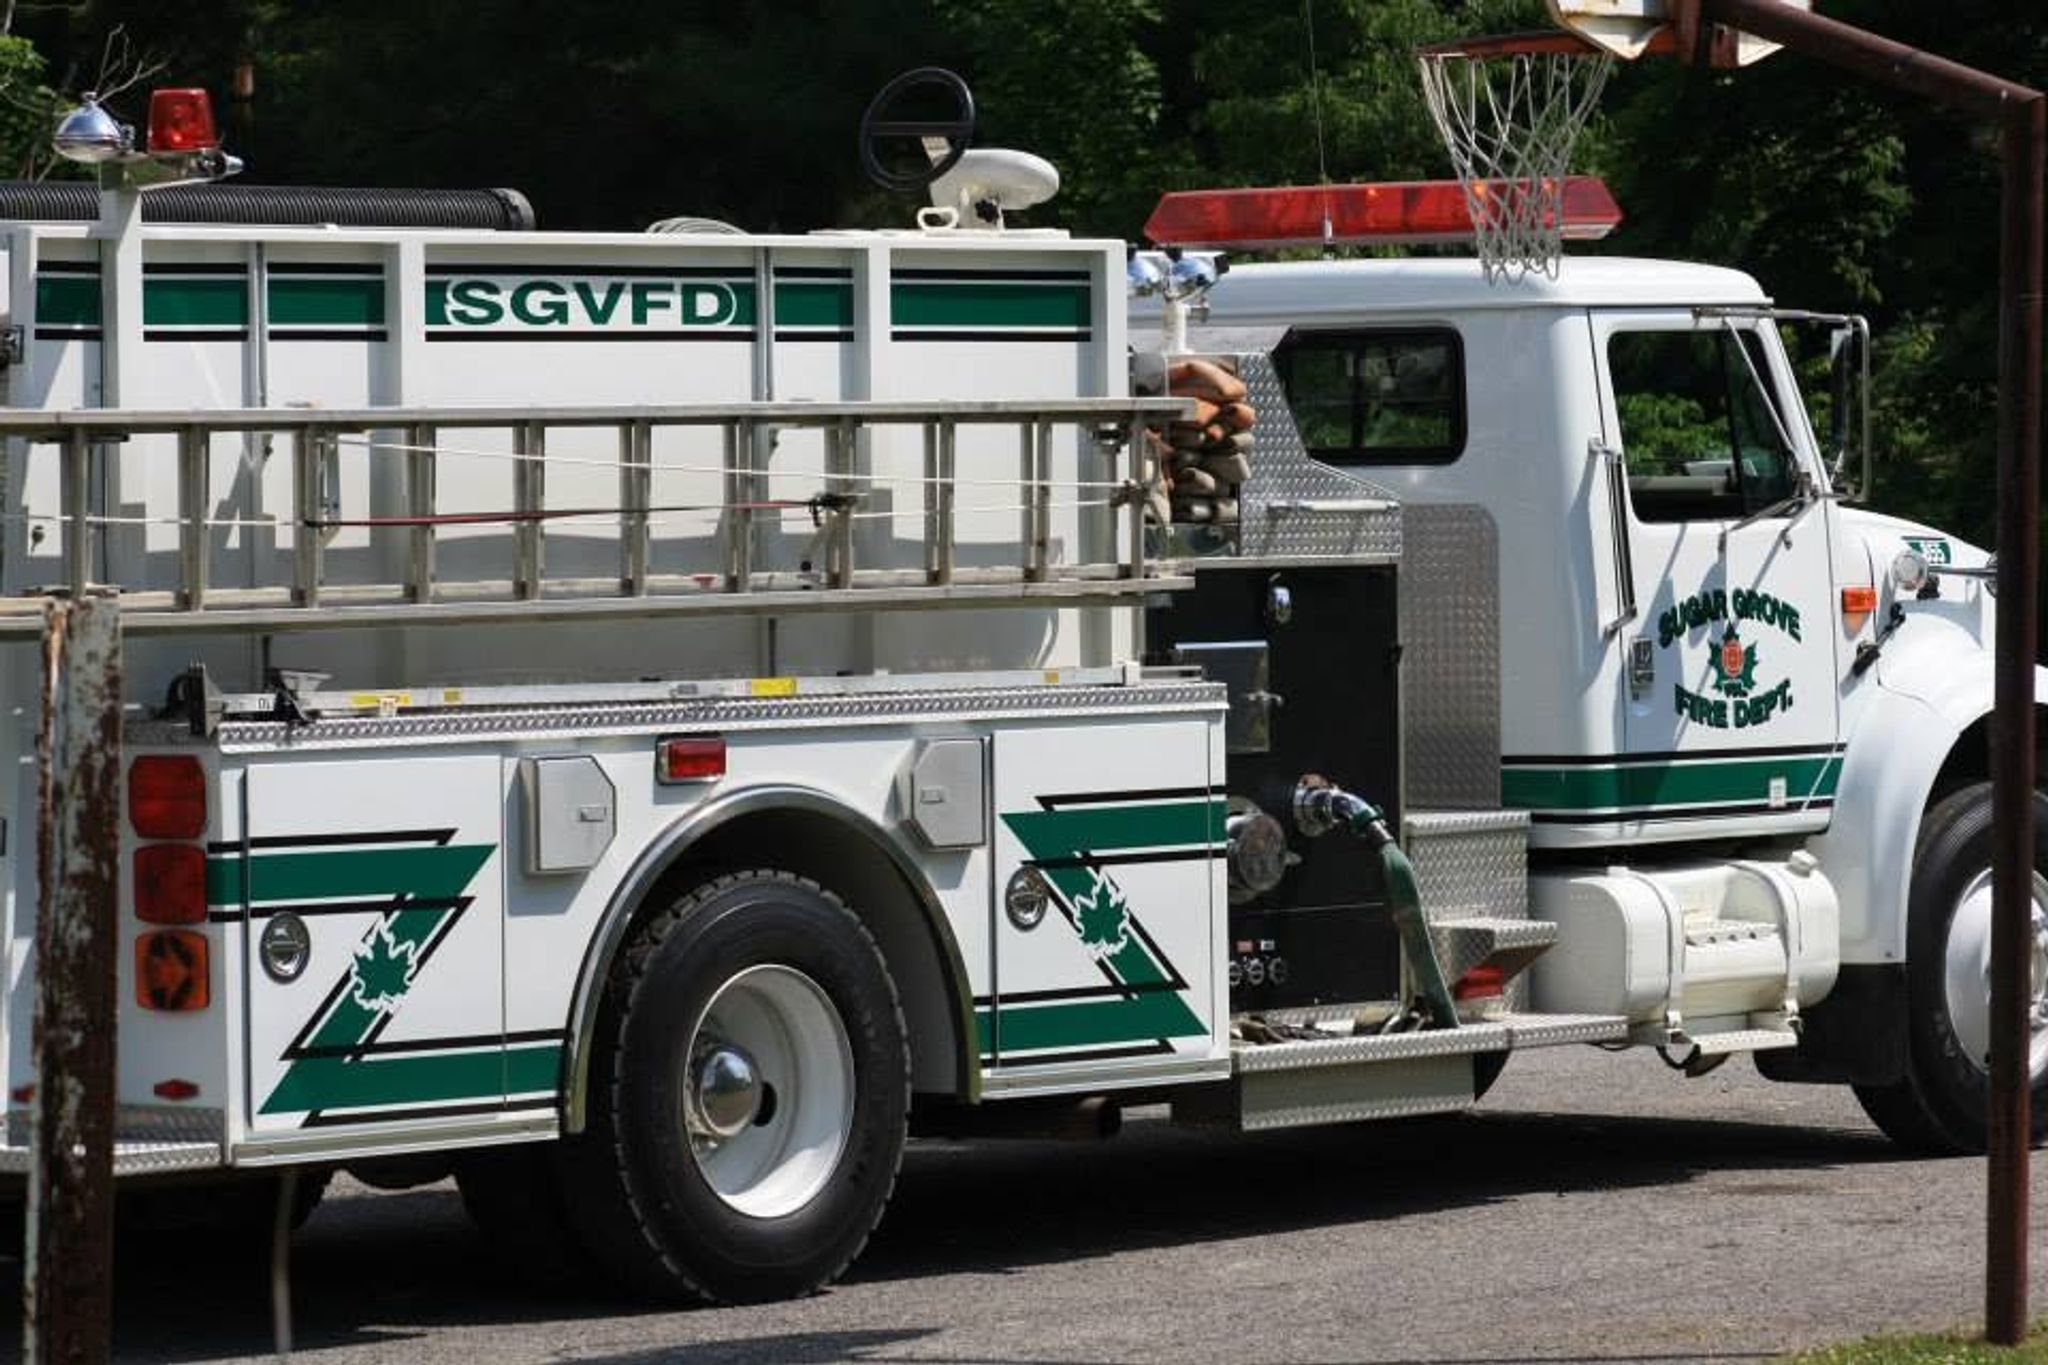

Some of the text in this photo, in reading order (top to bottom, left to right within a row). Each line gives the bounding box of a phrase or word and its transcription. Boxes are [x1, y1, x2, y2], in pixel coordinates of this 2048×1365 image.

[450, 279, 734, 326] SGVFD
[1659, 588, 1801, 648] SUGAR GROVE
[1675, 683, 1728, 728] FIRE
